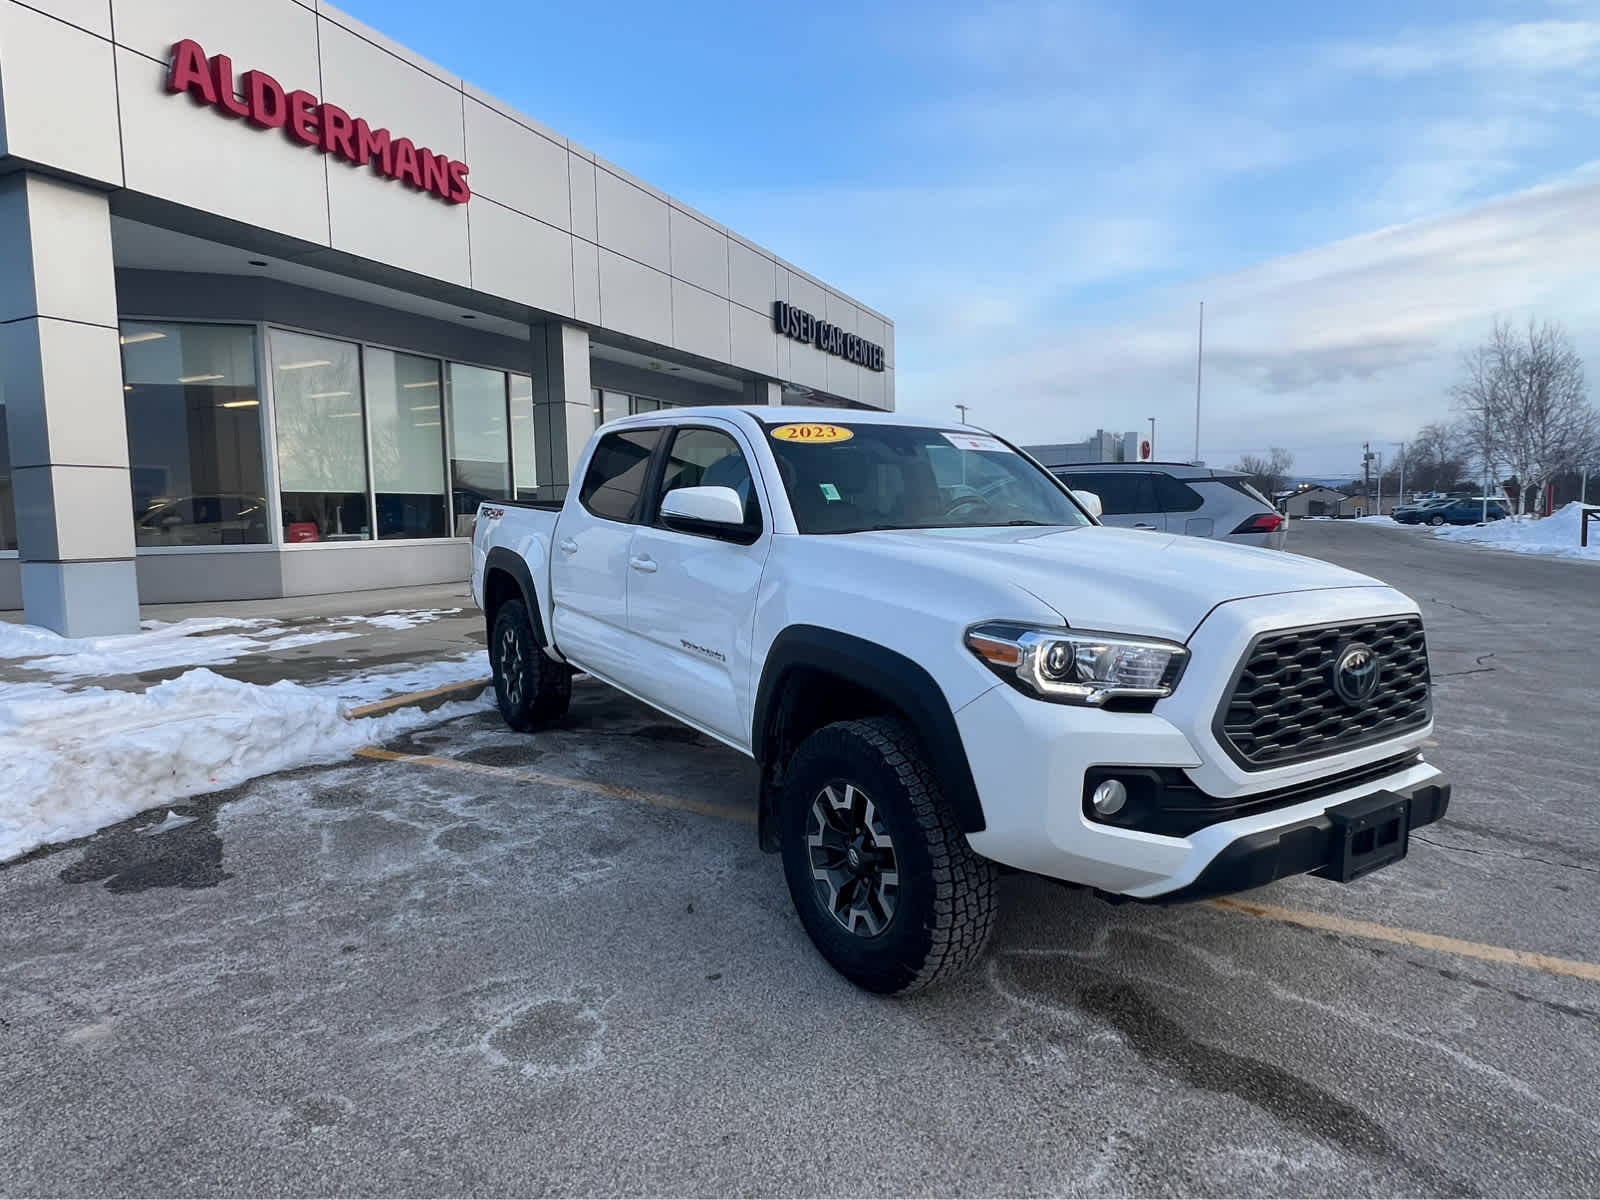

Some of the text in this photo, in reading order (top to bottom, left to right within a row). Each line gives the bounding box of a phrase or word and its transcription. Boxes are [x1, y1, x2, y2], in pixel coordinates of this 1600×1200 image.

[168, 38, 471, 204] ALDERMANS
[776, 301, 884, 371] USED CAR CENTER
[787, 426, 837, 439] 2023
